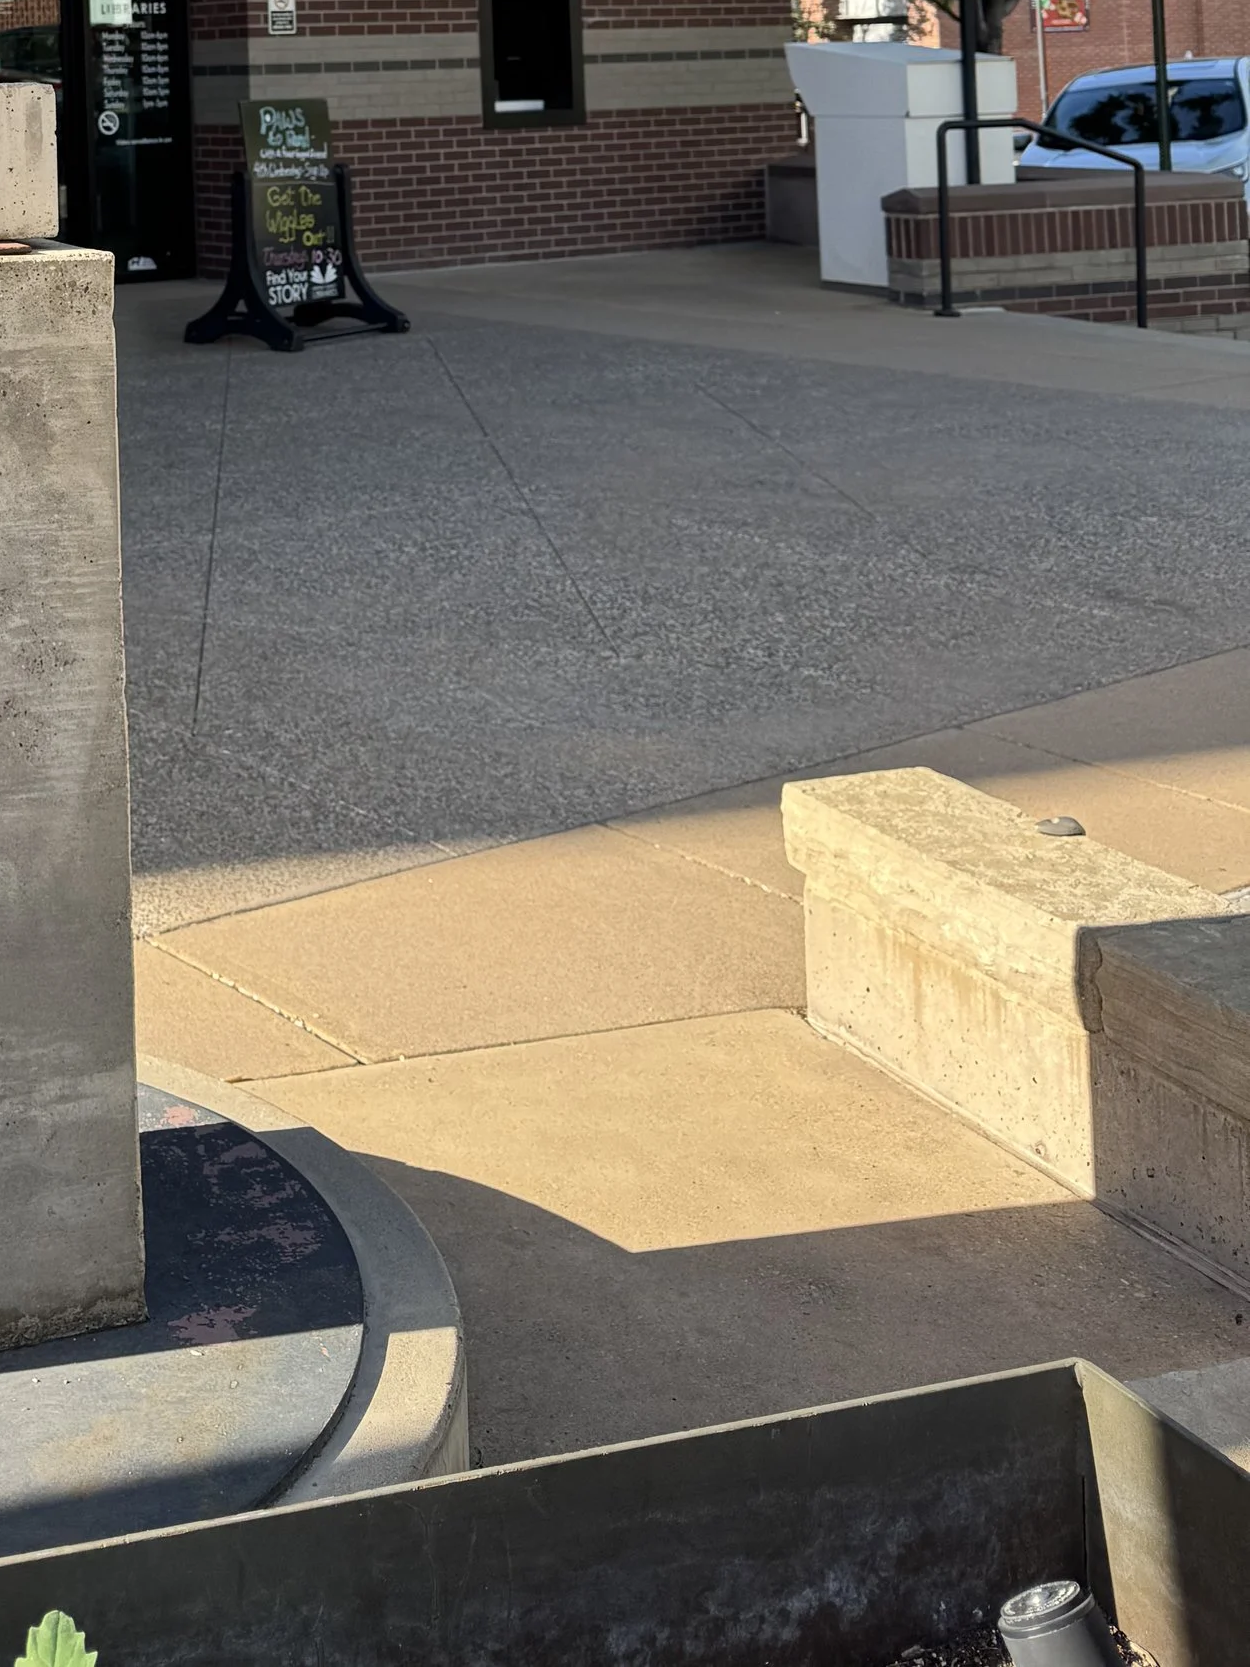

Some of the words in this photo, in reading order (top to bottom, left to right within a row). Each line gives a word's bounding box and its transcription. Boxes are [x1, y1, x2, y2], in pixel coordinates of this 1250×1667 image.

[101, 1, 167, 15] LIBRARIES
[267, 186, 294, 207] Get
[266, 269, 286, 285] Find
[287, 267, 308, 283] Your
[268, 283, 308, 305] STORY
